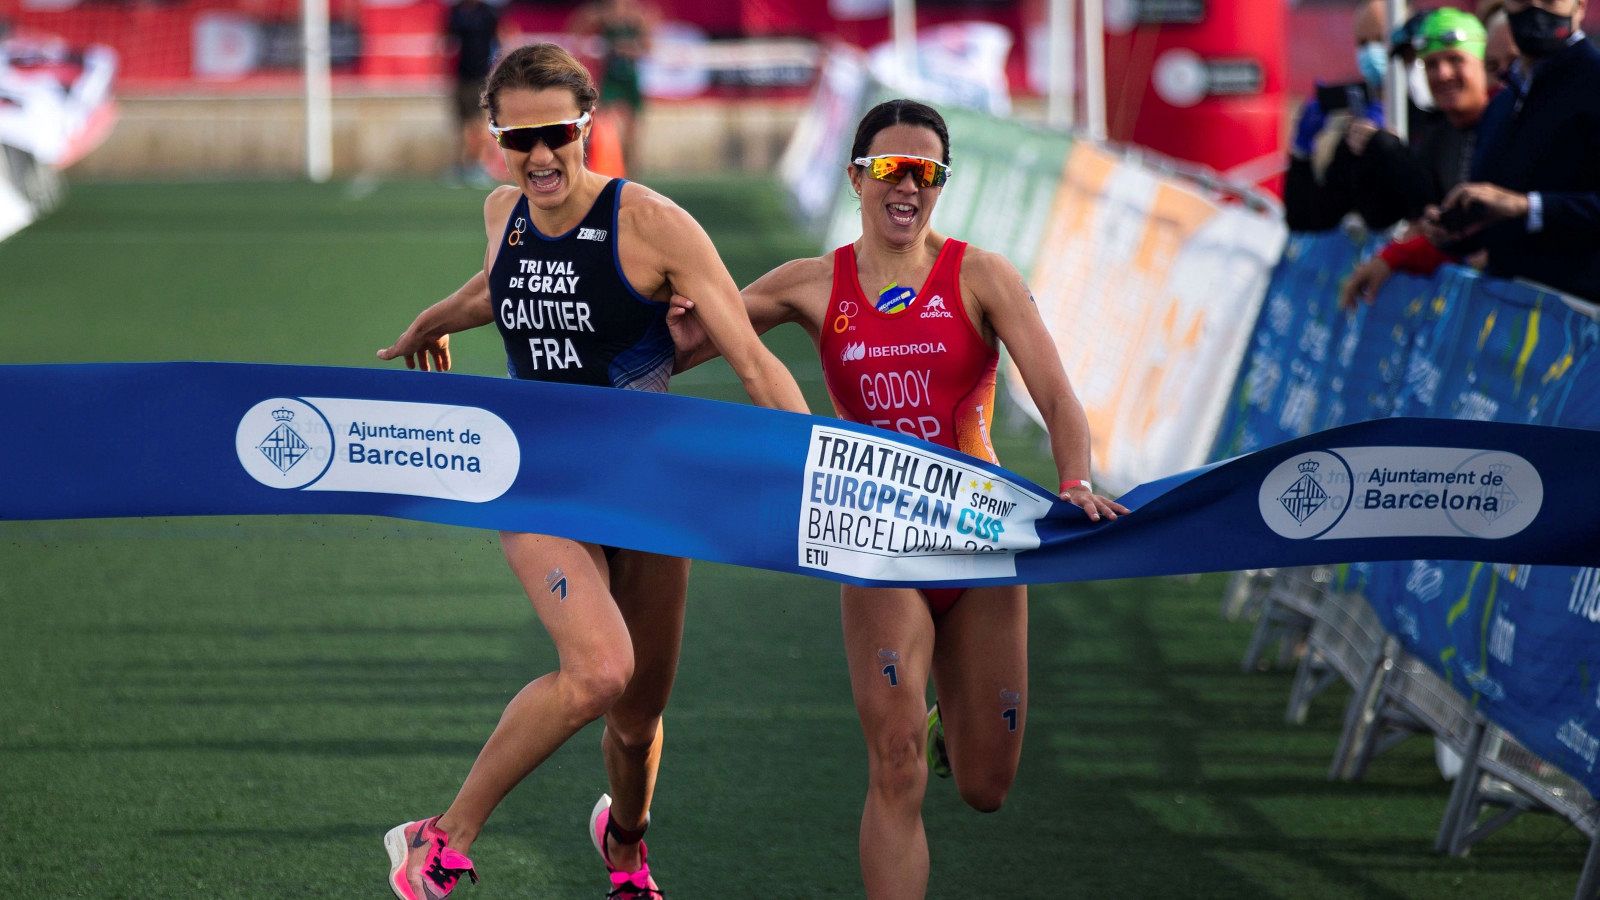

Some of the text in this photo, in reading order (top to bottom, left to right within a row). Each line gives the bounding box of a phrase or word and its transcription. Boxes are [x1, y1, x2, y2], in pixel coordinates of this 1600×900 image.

[519, 259, 575, 275] TRI VAL
[509, 276, 580, 294] DE GRAY
[500, 298, 595, 333] GAUTIER
[528, 338, 583, 371] FRA
[868, 341, 947, 358] IBERDROLA
[860, 369, 931, 412] GODOY
[348, 421, 481, 445] Ajuntament de
[349, 442, 481, 474] Barcelona
[816, 435, 963, 501] TRIATHLON
[1368, 467, 1504, 487] Ajuntament de
[810, 471, 953, 530] EUROPEAN
[970, 492, 1018, 518] SPRINT
[1364, 488, 1499, 512] Barcelona
[956, 507, 1005, 543] CUP
[806, 547, 829, 567] ETU
[550, 576, 568, 601] 1
[882, 664, 898, 687] 1
[1002, 708, 1017, 732] 1
